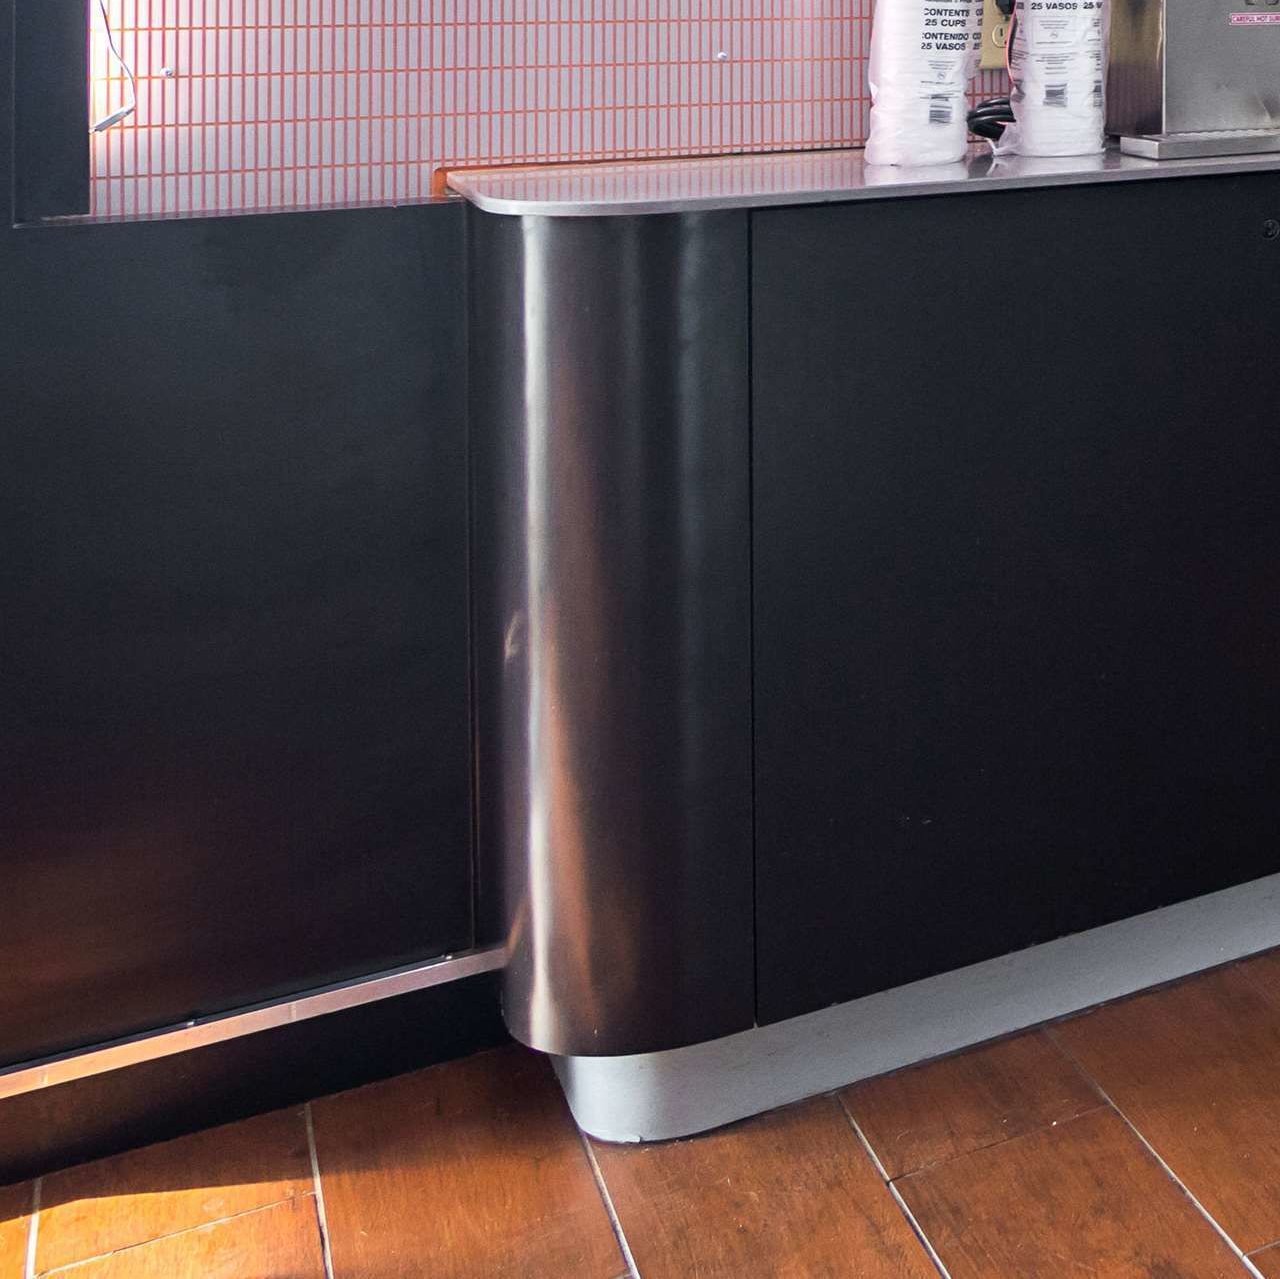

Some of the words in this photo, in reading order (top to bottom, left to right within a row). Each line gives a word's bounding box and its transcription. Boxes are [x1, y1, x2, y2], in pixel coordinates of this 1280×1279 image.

[1031, 2, 1043, 10] 25
[1045, 2, 1078, 11] VASOS
[925, 18, 938, 26] 25
[941, 19, 967, 27] CUPS
